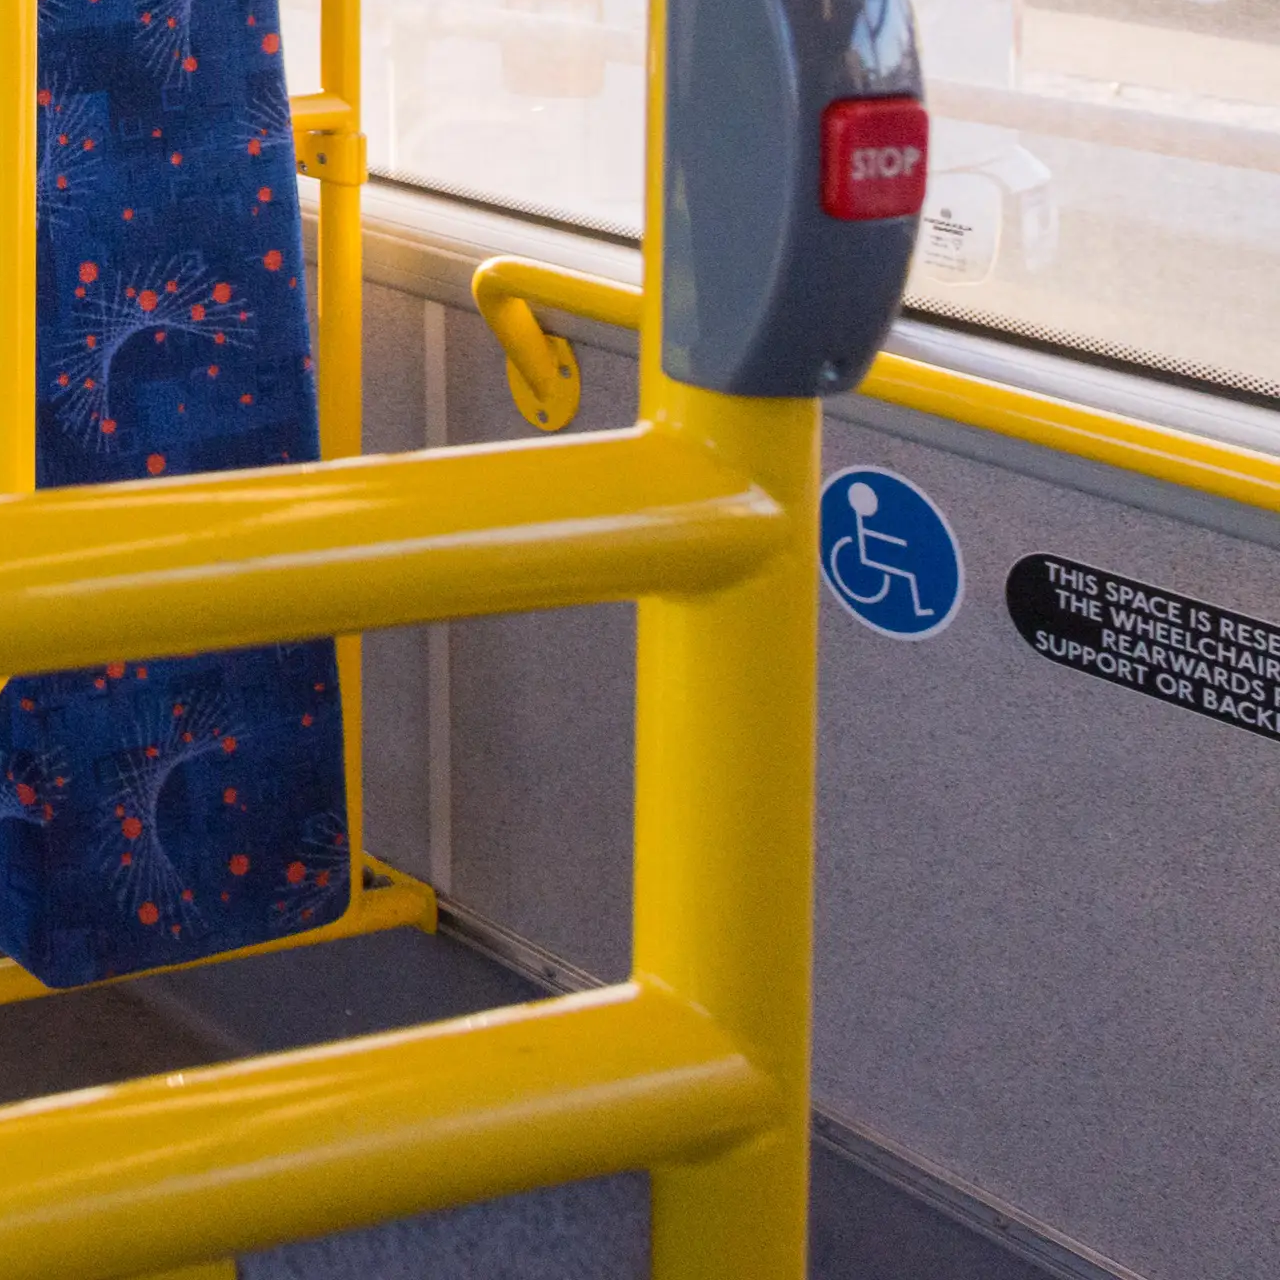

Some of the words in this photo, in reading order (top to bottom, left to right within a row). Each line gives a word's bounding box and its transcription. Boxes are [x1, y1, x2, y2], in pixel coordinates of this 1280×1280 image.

[850, 146, 921, 180] STOP
[1044, 561, 1099, 596] THIS
[1105, 581, 1183, 624] SPACE
[1190, 607, 1212, 632] IS
[1035, 629, 1149, 686] SUPPORT
[1156, 672, 1195, 704] OR
[1055, 588, 1104, 622] THE
[1109, 606, 1280, 681] WHEELCHAIR
[1101, 628, 1266, 702] REARWARDS
